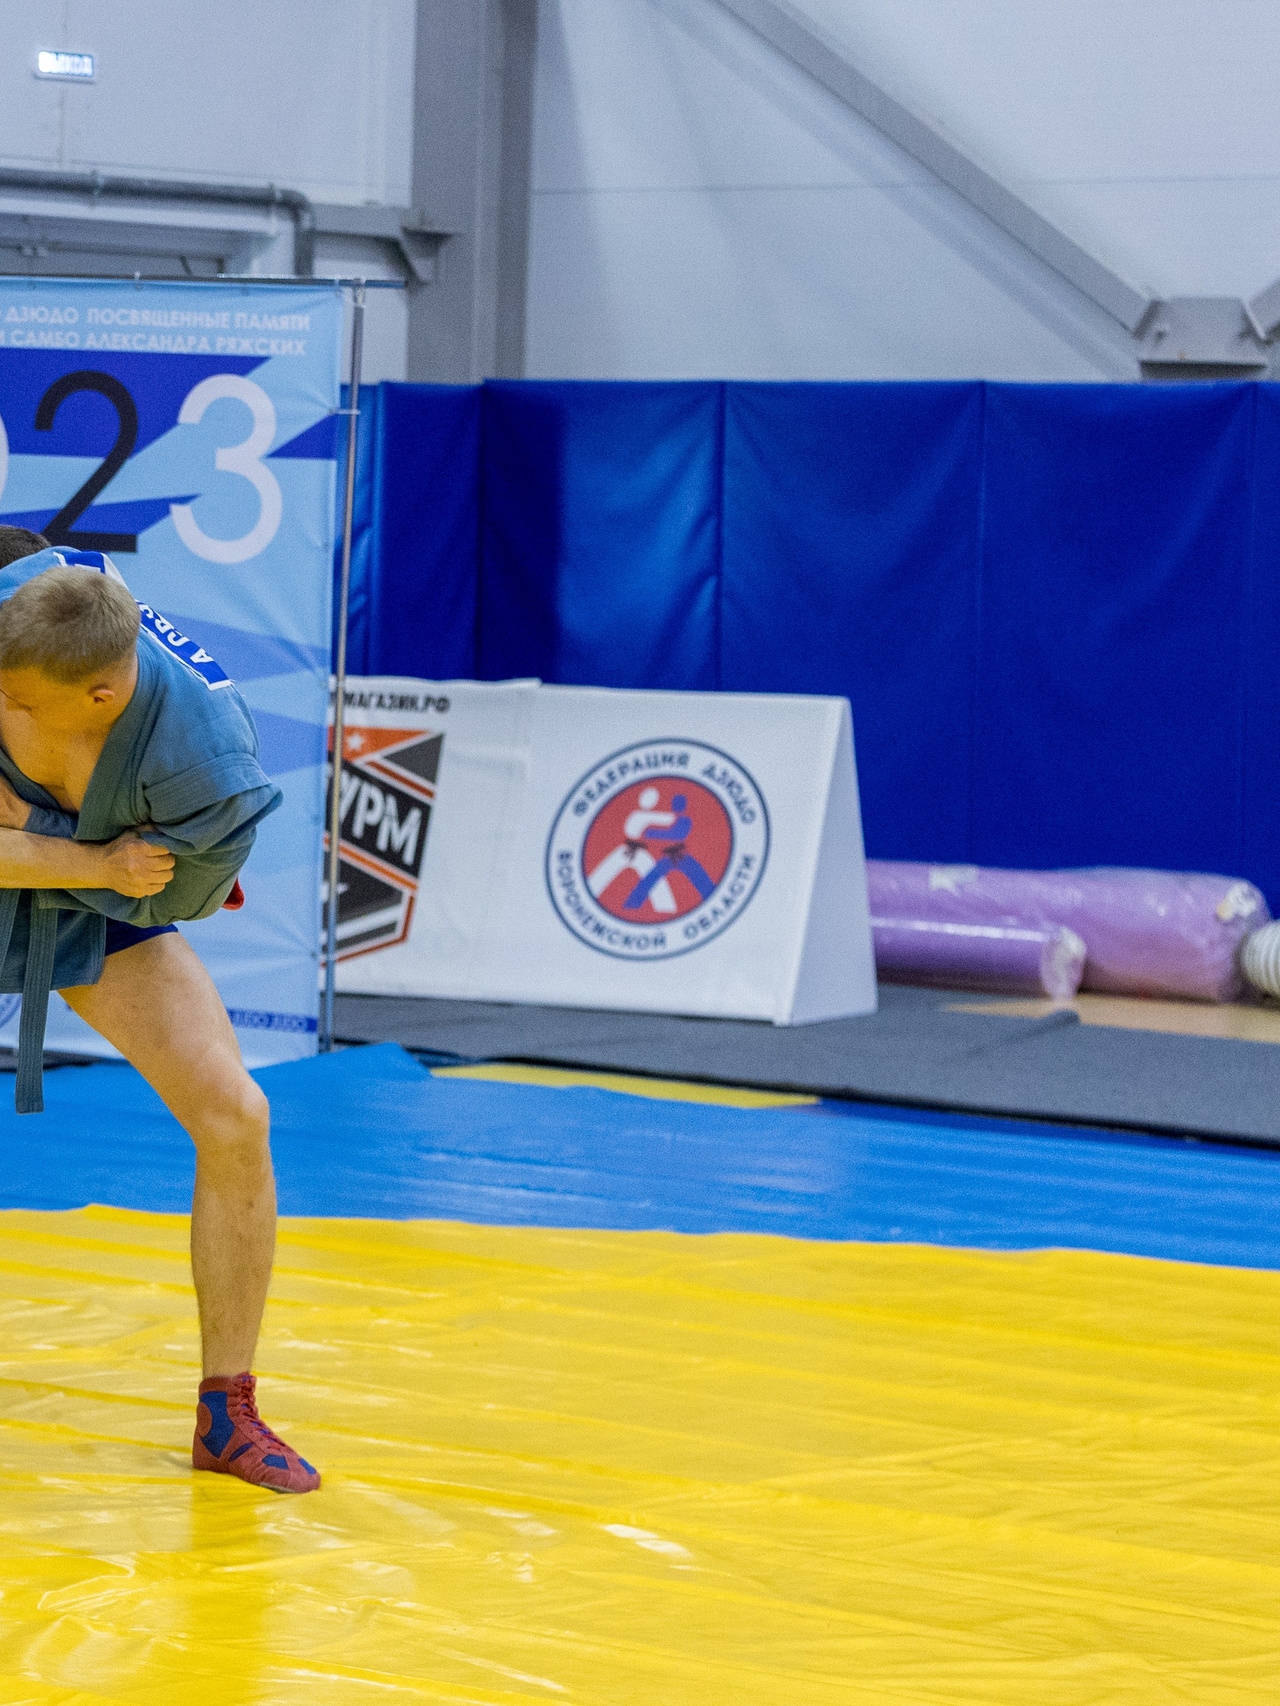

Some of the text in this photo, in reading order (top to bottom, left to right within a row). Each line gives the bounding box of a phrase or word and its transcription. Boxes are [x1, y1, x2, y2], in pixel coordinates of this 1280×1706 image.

[5, 306, 79, 325] ДЗЮДО
[87, 308, 231, 329] ПОСВЯЩЕННЫЕ
[234, 312, 310, 331] ПАМЯТИ
[11, 329, 81, 348] САМБО
[86, 332, 211, 352] АЛЕКСАНДРА
[216, 336, 307, 356] РЯЖСКИХ
[332, 766, 422, 867] УРМ
[572, 752, 757, 826] ФЕДЕРАЦИЯ ДЗЮДО
[557, 851, 755, 950] ВОРОНЕЖСКОЙ ОБЛАСТИ
